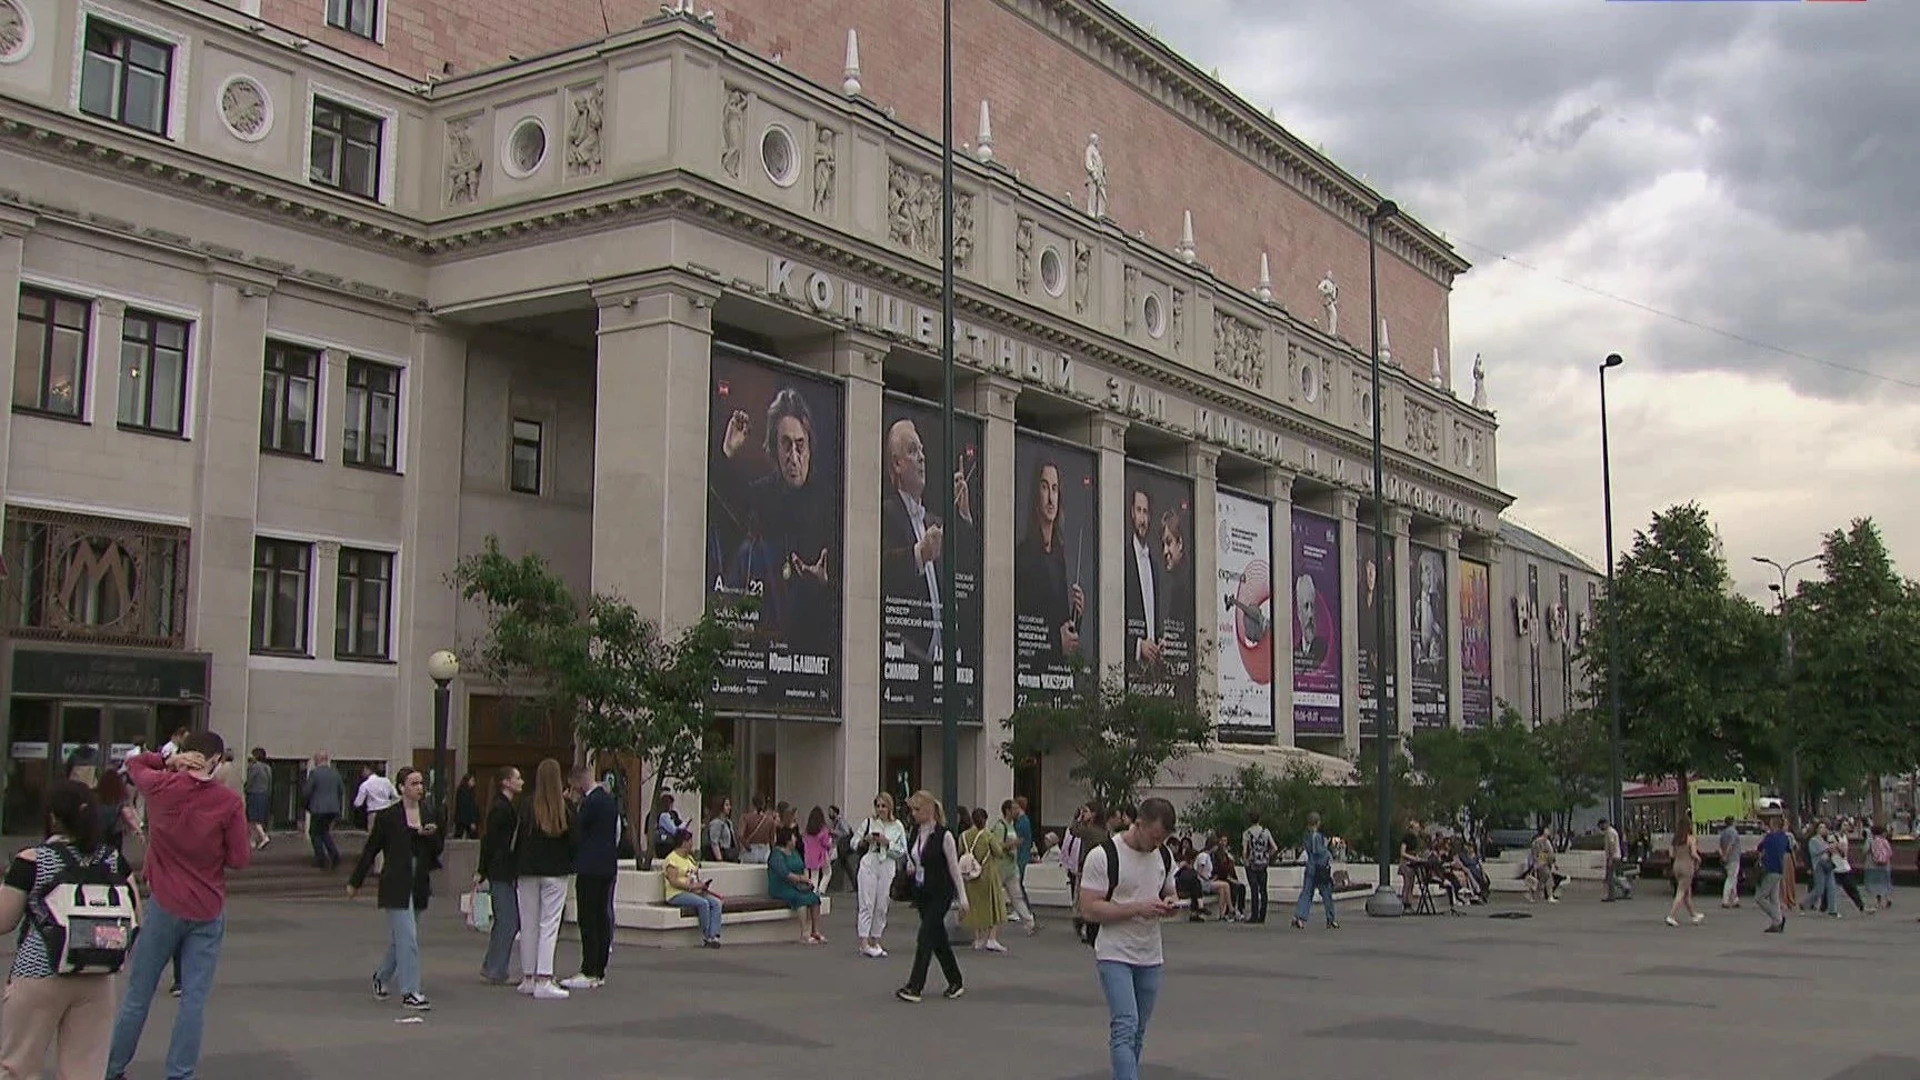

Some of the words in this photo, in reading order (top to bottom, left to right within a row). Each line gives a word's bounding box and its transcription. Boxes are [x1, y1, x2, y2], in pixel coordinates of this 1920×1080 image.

[1106, 377, 1166, 423] ЗАЛ
[1195, 408, 1283, 461] ИМЕНИ
[738, 659, 765, 670] РОССИЯ
[769, 652, 792, 675] Юрий
[793, 653, 829, 675] БАШМЕТ
